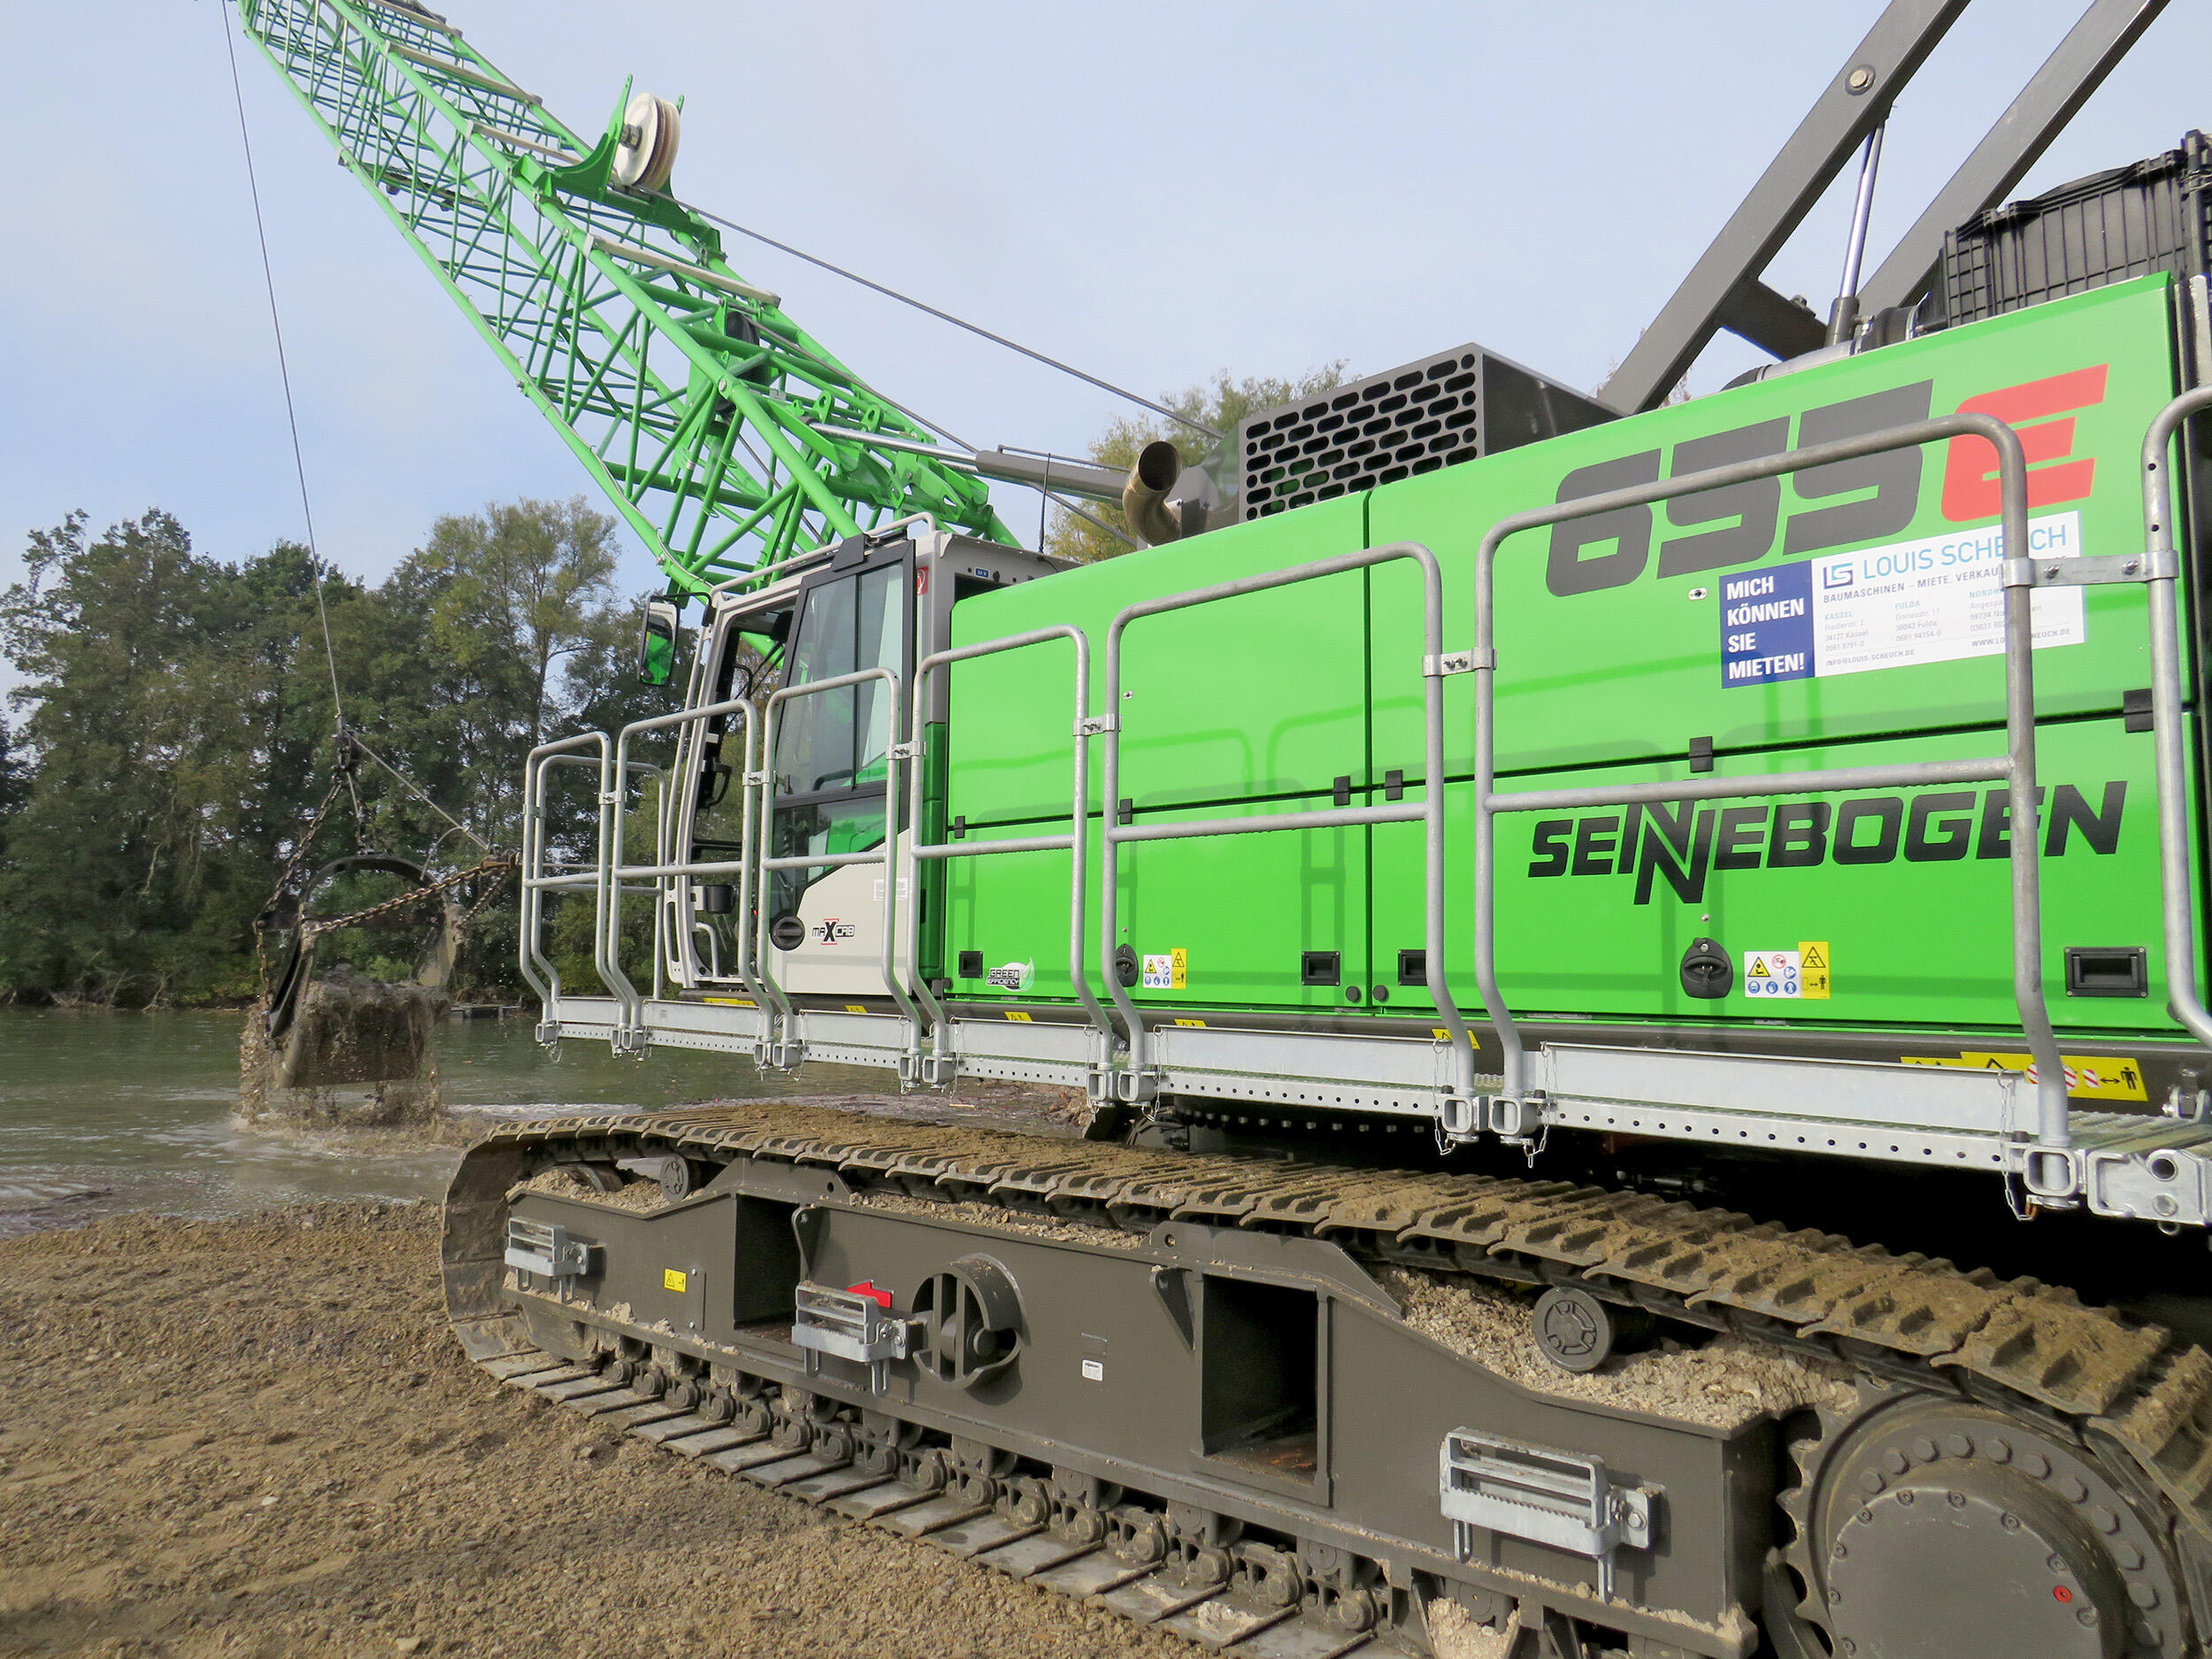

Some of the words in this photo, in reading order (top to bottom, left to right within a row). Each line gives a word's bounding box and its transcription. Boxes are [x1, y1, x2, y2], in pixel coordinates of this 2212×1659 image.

[1863, 548, 1934, 580] LOUIS
[1941, 525, 2066, 566] SCHECH
[1726, 575, 1775, 601] MICH
[1823, 582, 1905, 603] BAUMASCHINEN
[1955, 566, 2003, 583] VERKAU
[1969, 588, 2004, 599] NORDH
[1727, 597, 1805, 627] KÖNNEN
[1824, 611, 1854, 621] KASSEL
[1894, 600, 1921, 611] FULDA
[1727, 632, 1756, 654] SIE
[1728, 651, 1806, 680] MIETEN!
[1825, 649, 1915, 667] INFO@LOUIS-SCHEUCH.DE
[1527, 780, 2128, 905] SENNEBOGEN
[989, 969, 1020, 978] GREEN
